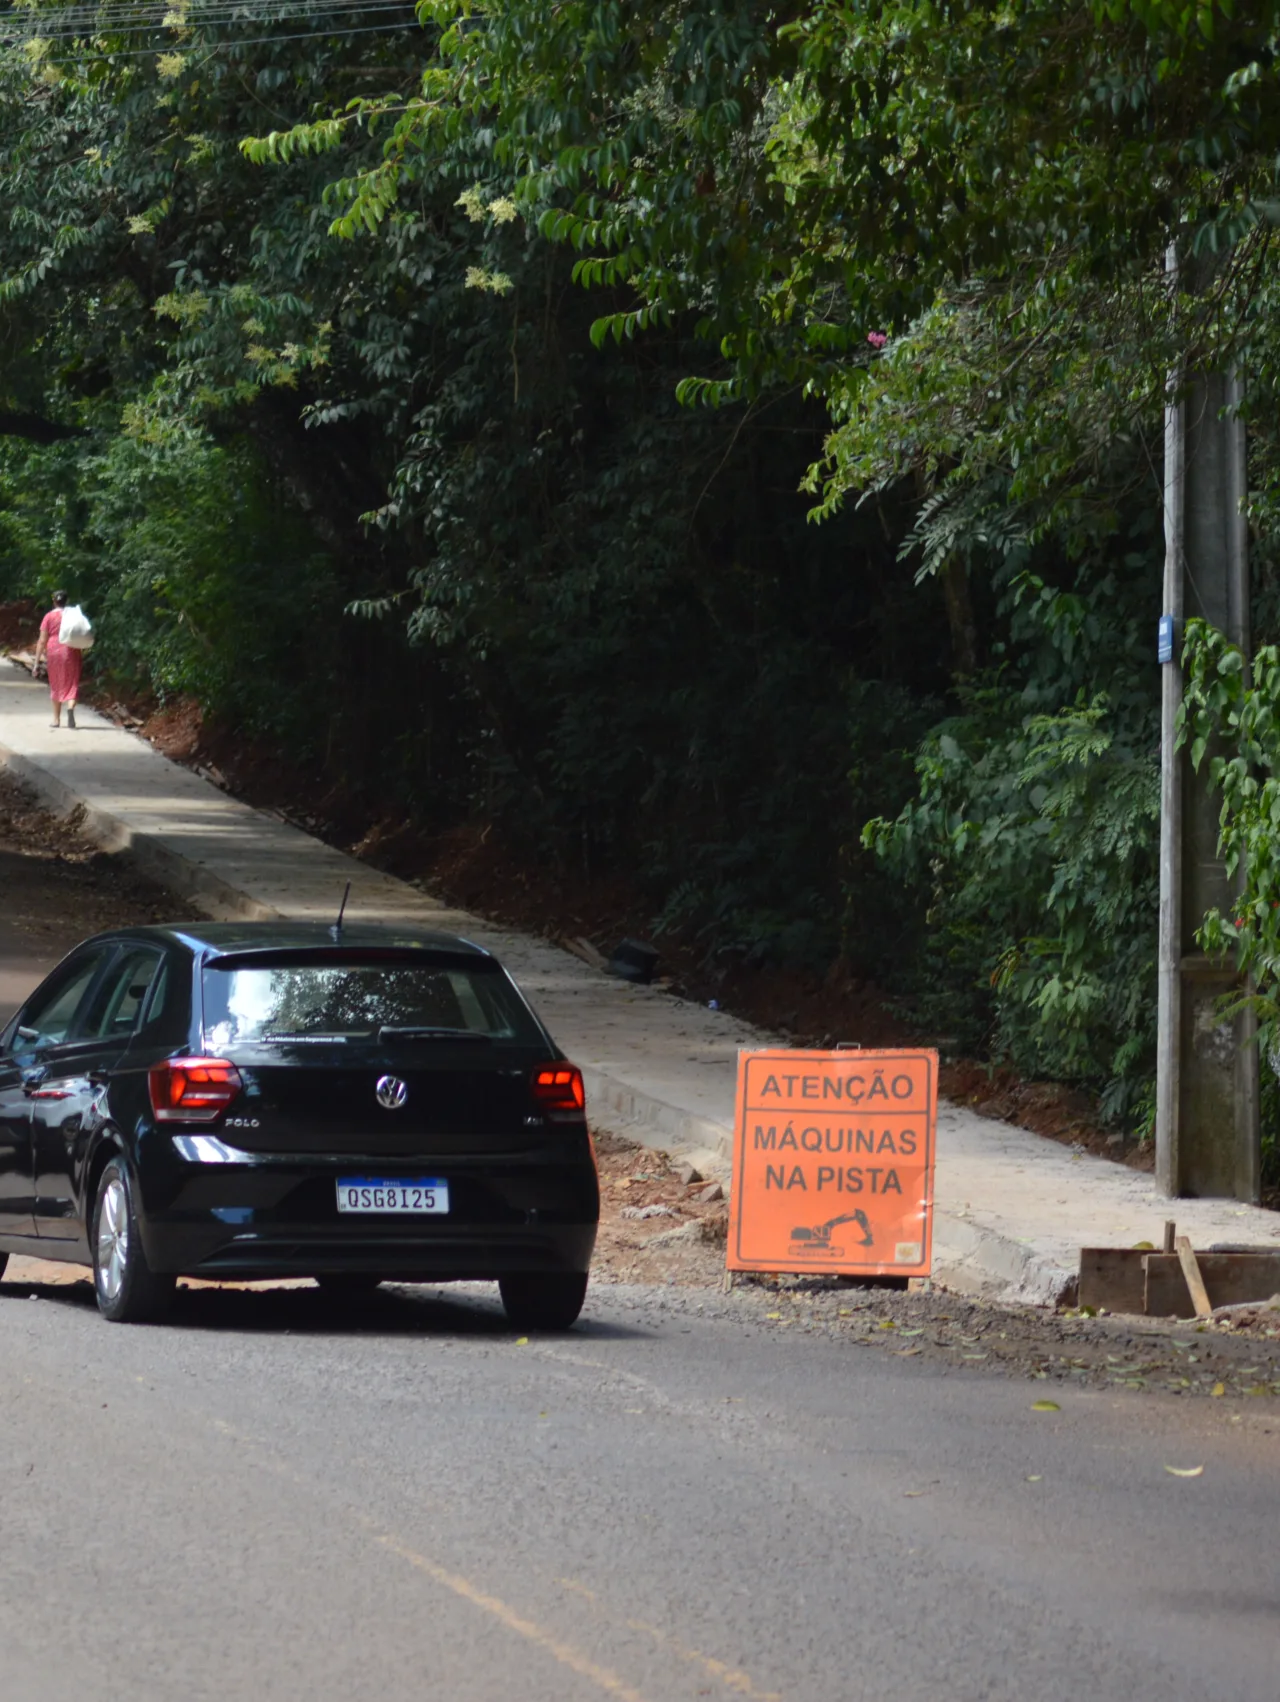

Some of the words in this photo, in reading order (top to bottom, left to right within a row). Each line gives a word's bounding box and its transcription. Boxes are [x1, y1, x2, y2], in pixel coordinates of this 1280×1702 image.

[760, 1069, 914, 1105] ATENÇÃO
[225, 1118, 260, 1127] POLO
[753, 1120, 917, 1155] MÁQUINAS
[765, 1164, 808, 1192] NA
[816, 1166, 903, 1195] PISTA
[347, 1188, 435, 1209] QSG8I25
